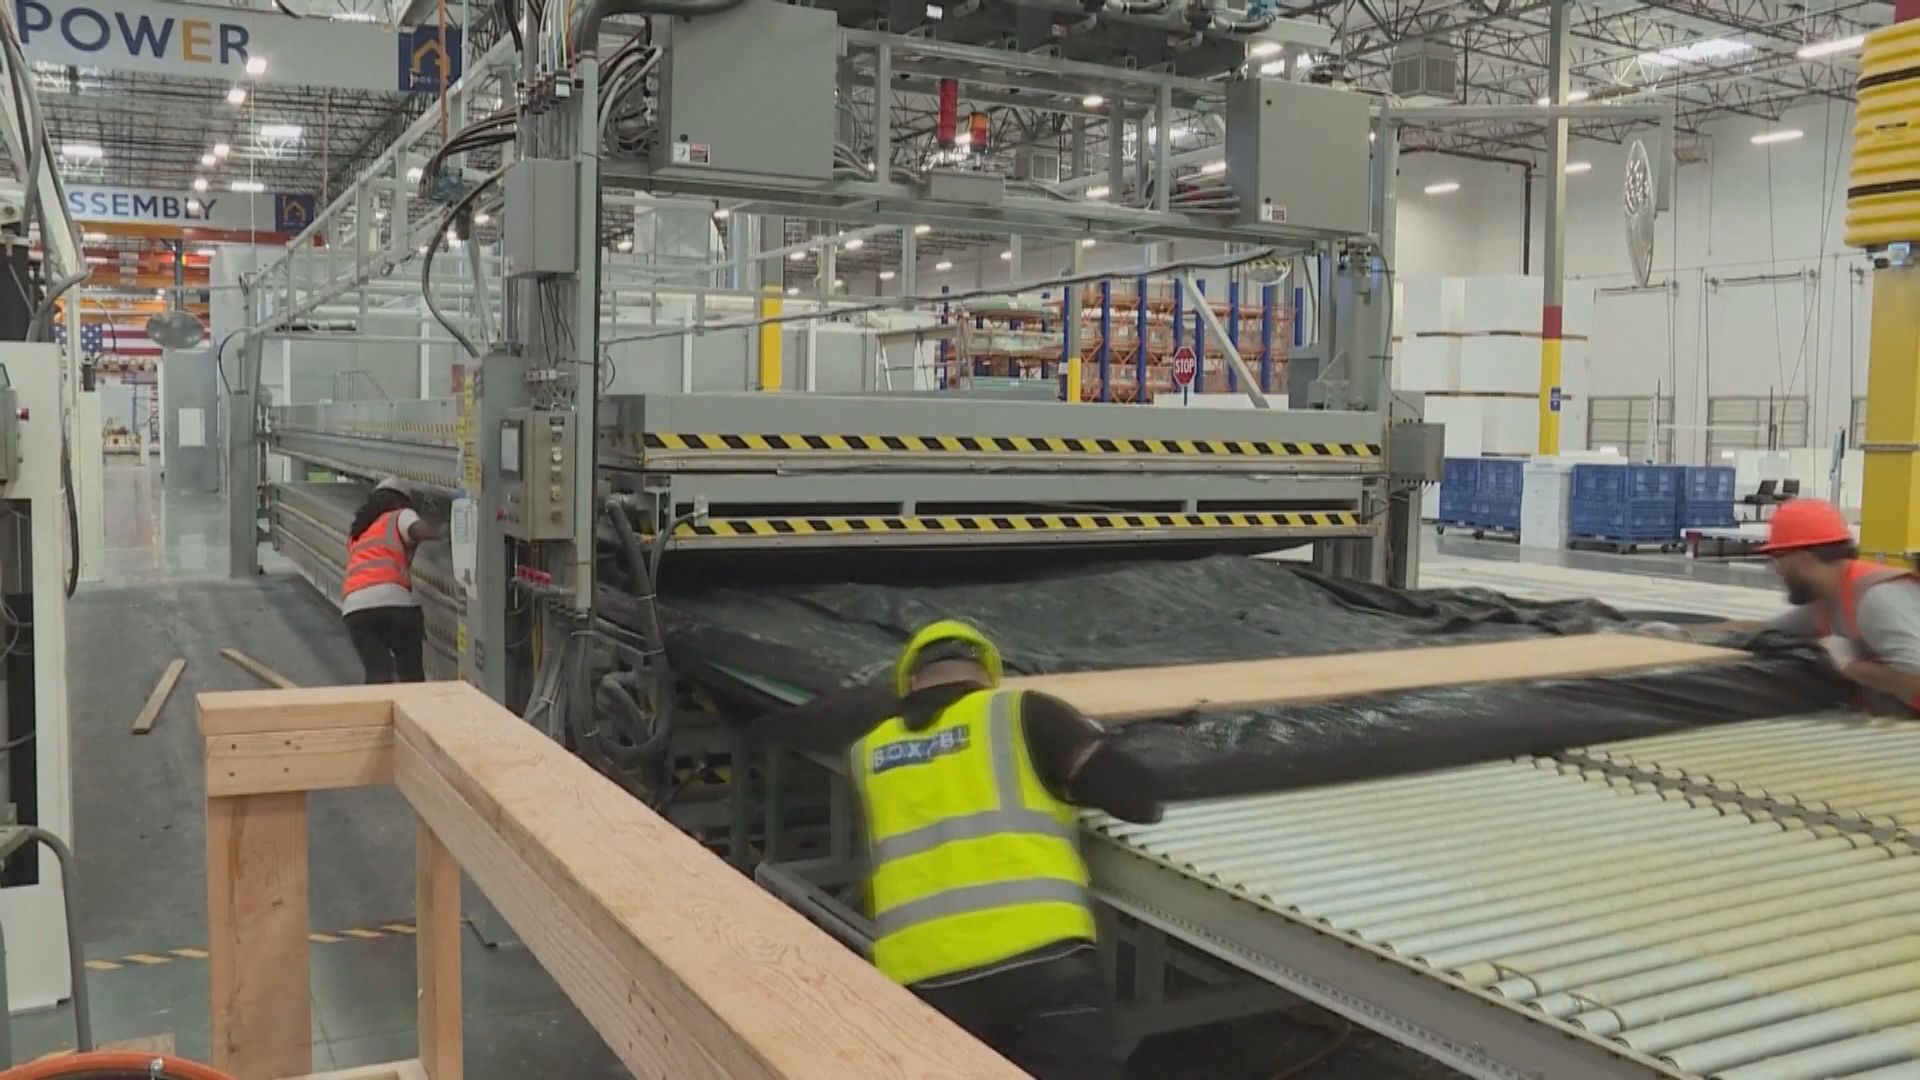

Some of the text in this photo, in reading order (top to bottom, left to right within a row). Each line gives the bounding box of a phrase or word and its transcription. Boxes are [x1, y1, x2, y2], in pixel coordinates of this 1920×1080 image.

[16, 0, 250, 64] POWER
[69, 191, 217, 221] SSEMBLY
[1175, 358, 1195, 374] STOP
